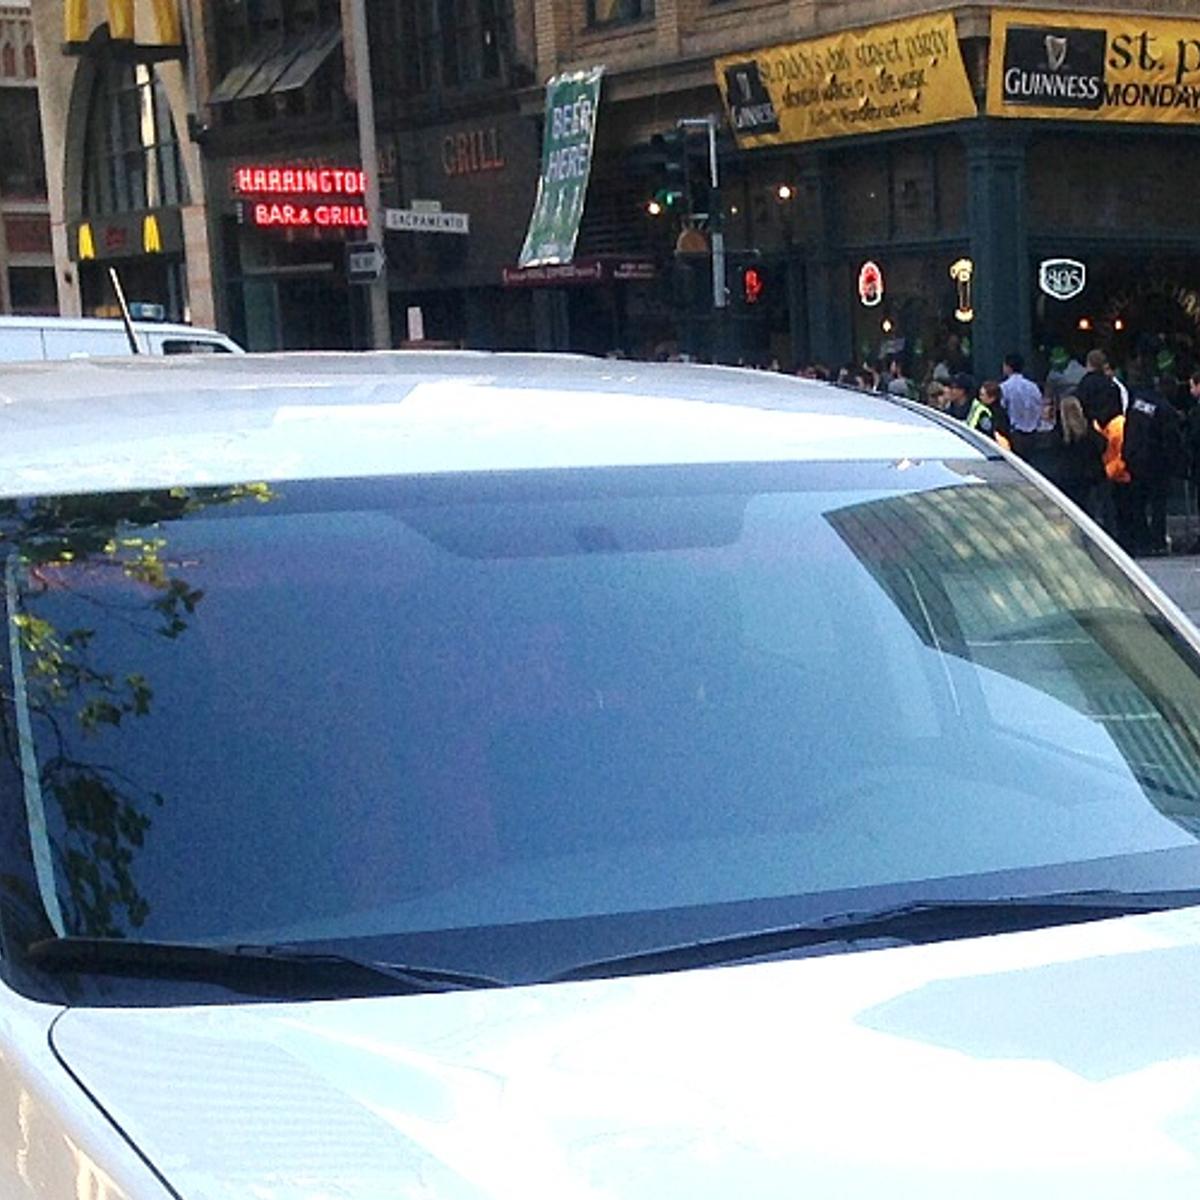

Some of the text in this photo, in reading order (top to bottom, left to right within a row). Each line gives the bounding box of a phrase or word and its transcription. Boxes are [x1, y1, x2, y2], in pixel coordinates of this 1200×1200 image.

[1004, 67, 1100, 99] GUINNESS
[552, 98, 592, 139] BEER
[441, 128, 505, 175] GRILL
[544, 143, 589, 183] HERE
[254, 203, 297, 224] BAR
[391, 212, 464, 229] SACRAMENTO
